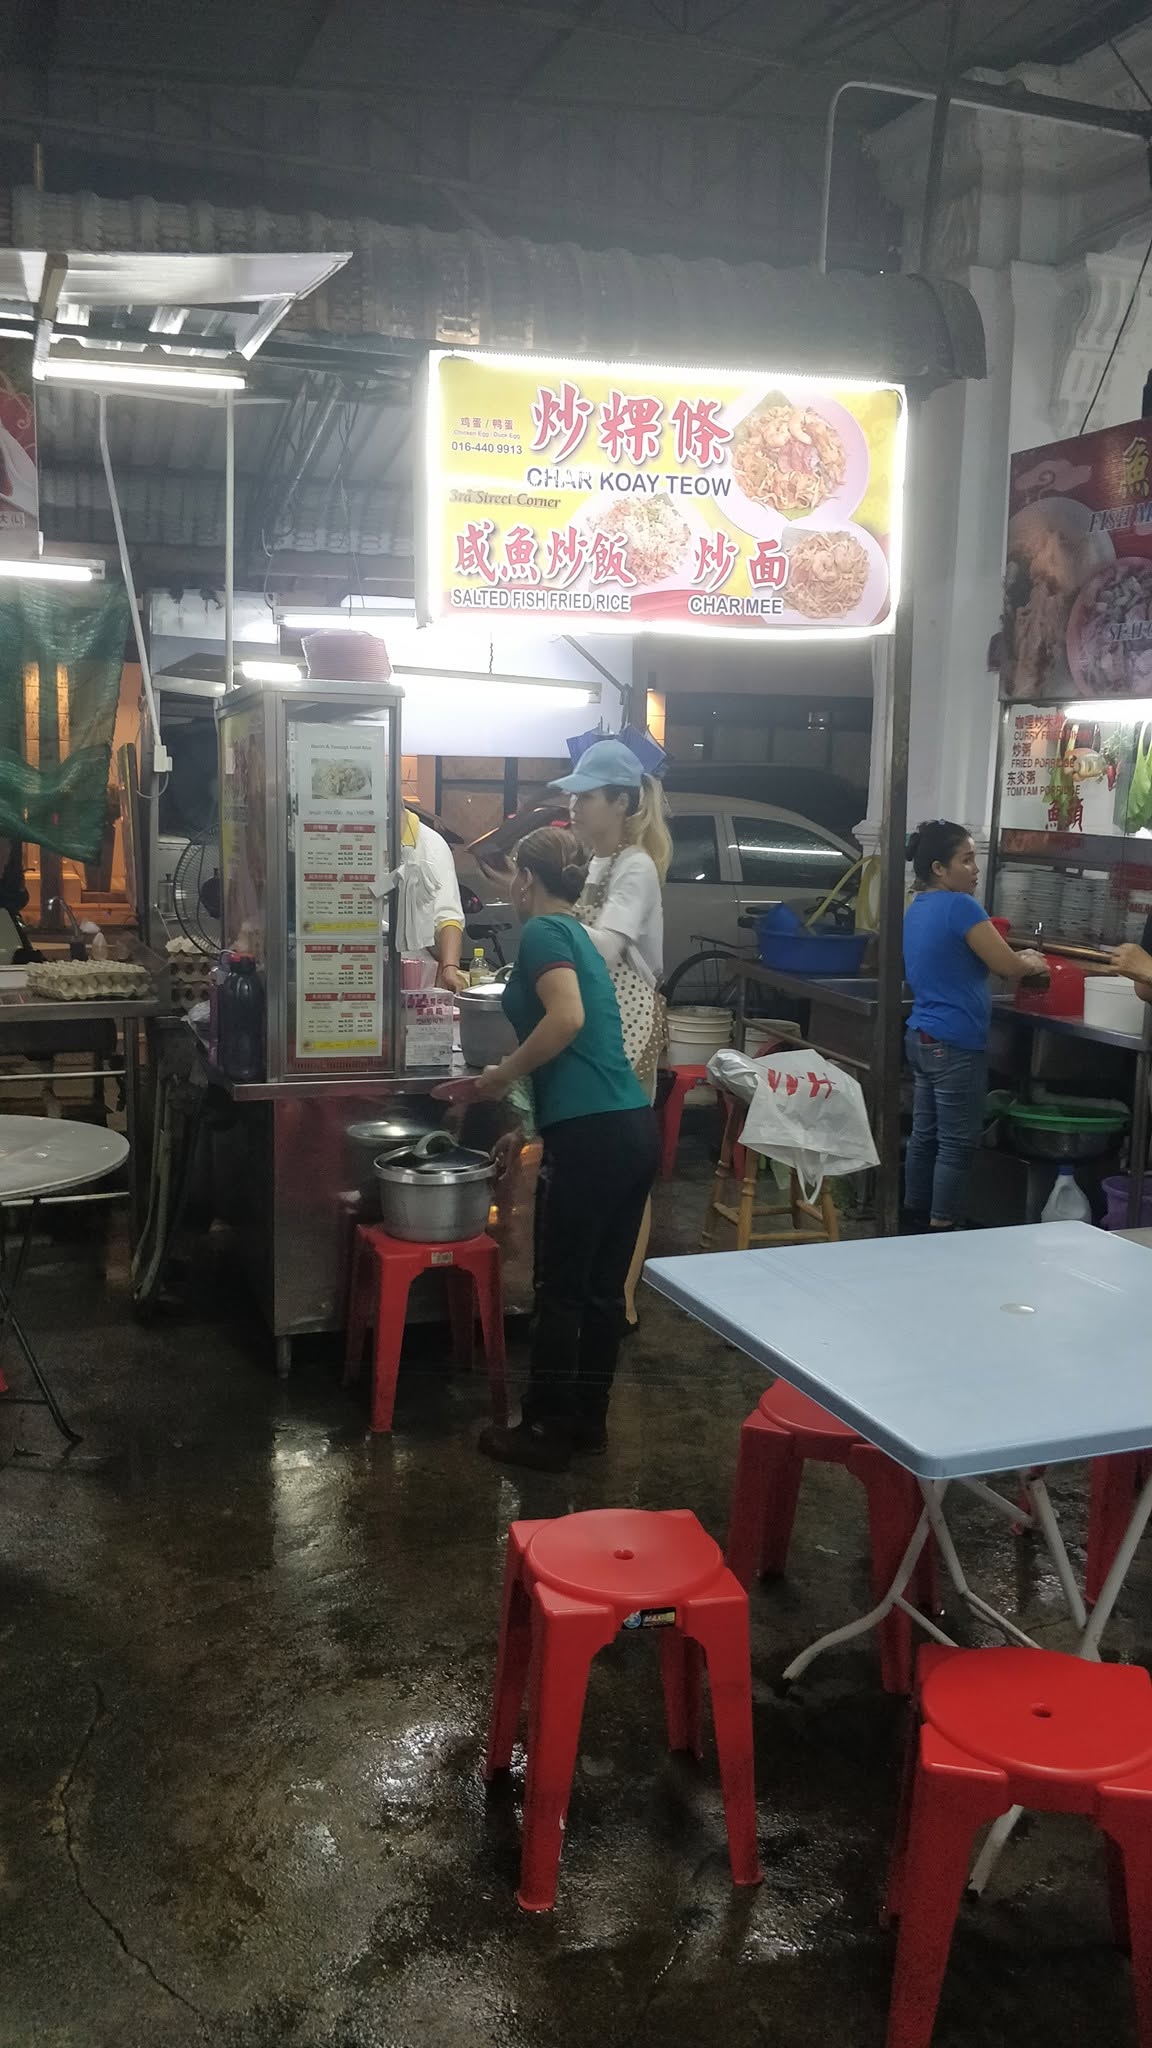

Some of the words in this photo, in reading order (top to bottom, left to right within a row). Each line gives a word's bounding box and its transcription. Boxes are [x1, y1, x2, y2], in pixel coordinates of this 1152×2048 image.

[532, 381, 732, 466] 炒粿條
[451, 441, 495, 453] 016-440
[496, 444, 523, 455] 9913
[527, 467, 593, 490] CHAR
[600, 472, 660, 493] KOAY
[665, 474, 732, 497] TEOW
[449, 488, 473, 503] 3rd
[475, 491, 512, 505] Street
[516, 493, 561, 509] Corner
[1089, 506, 1133, 533] FISH
[455, 521, 635, 584] 咸魚炒飯
[694, 531, 787, 588] 炒面
[453, 588, 509, 606] SALTED
[511, 591, 545, 608] FISH
[551, 592, 592, 609] FRIED
[597, 594, 629, 610] RICE
[690, 596, 742, 613] CHAR
[746, 599, 783, 614] MEE
[1013, 730, 1040, 741] CURRY
[1011, 759, 1033, 769] FRIED
[1006, 786, 1038, 797] TOMYAM
